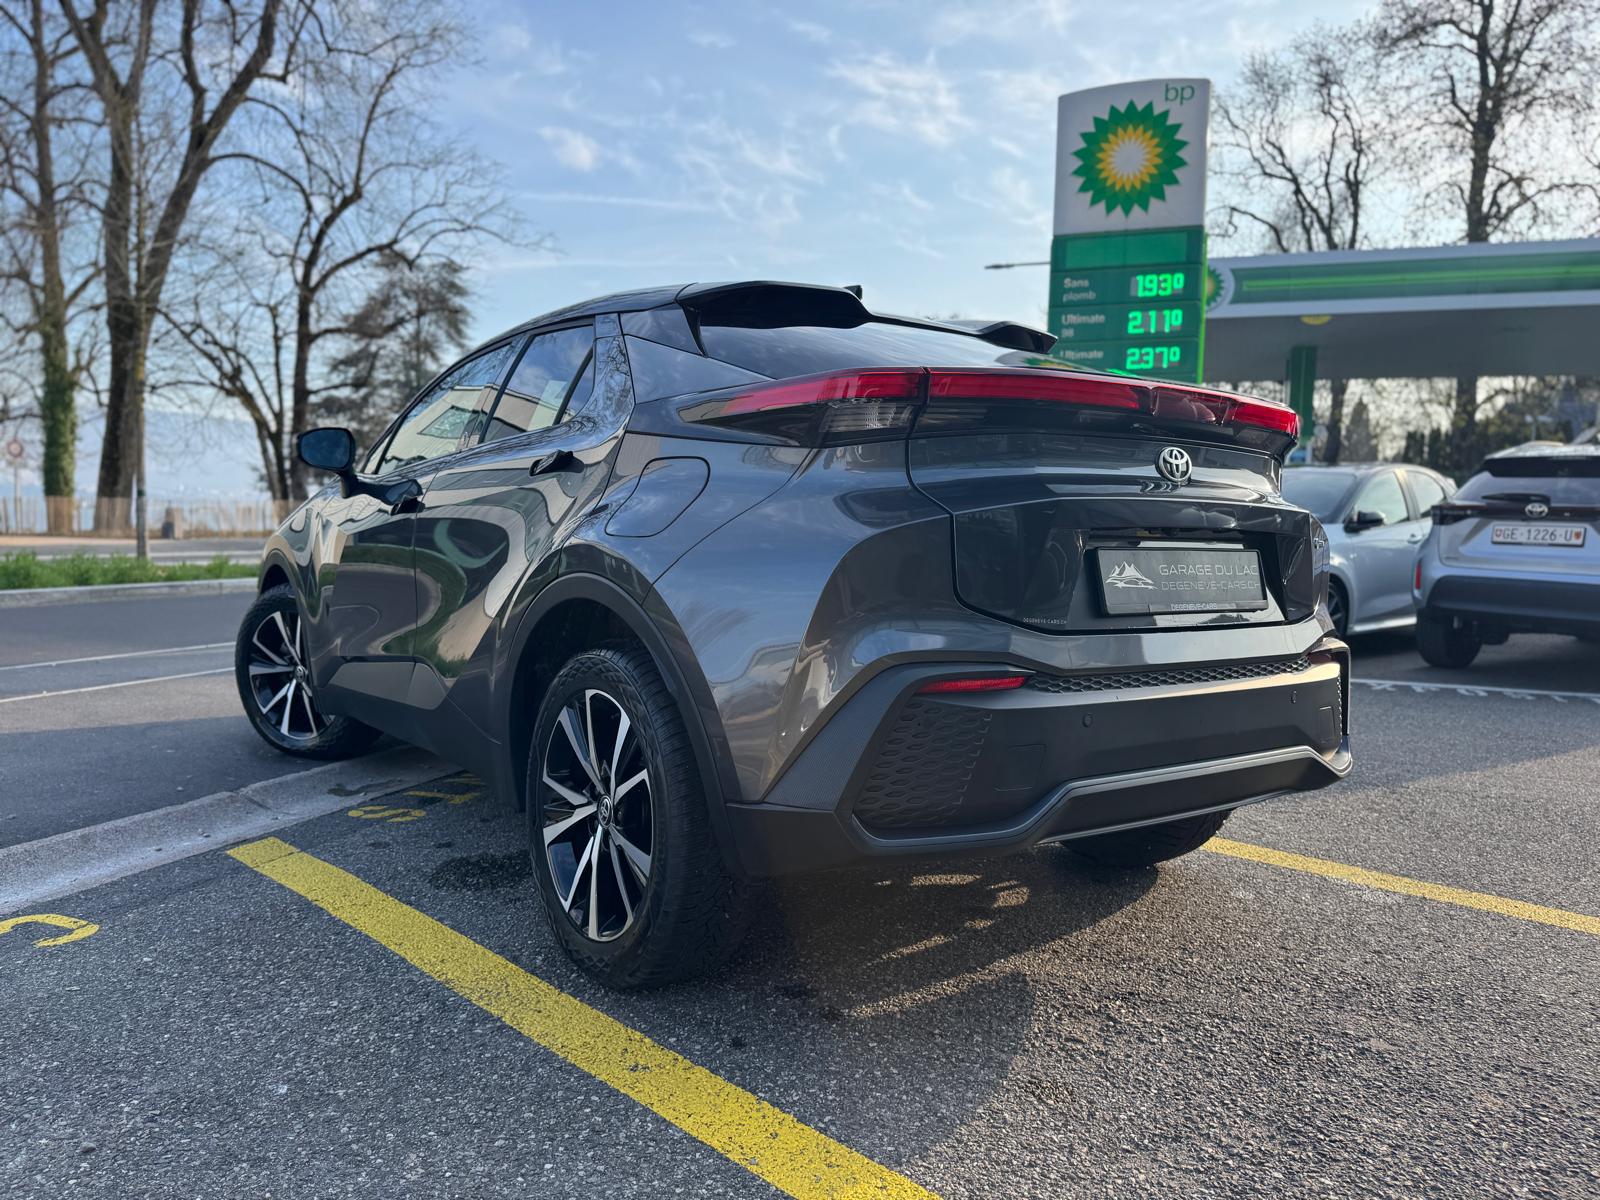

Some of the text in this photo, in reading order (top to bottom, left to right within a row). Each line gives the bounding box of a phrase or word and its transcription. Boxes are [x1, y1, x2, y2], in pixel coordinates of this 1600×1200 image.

[1164, 83, 1195, 105] bp
[1063, 278, 1090, 289] Sans
[1062, 291, 1097, 303] plomb
[1061, 314, 1105, 326] Ultimate
[1159, 564, 1258, 575] GARAGE DU LAC
